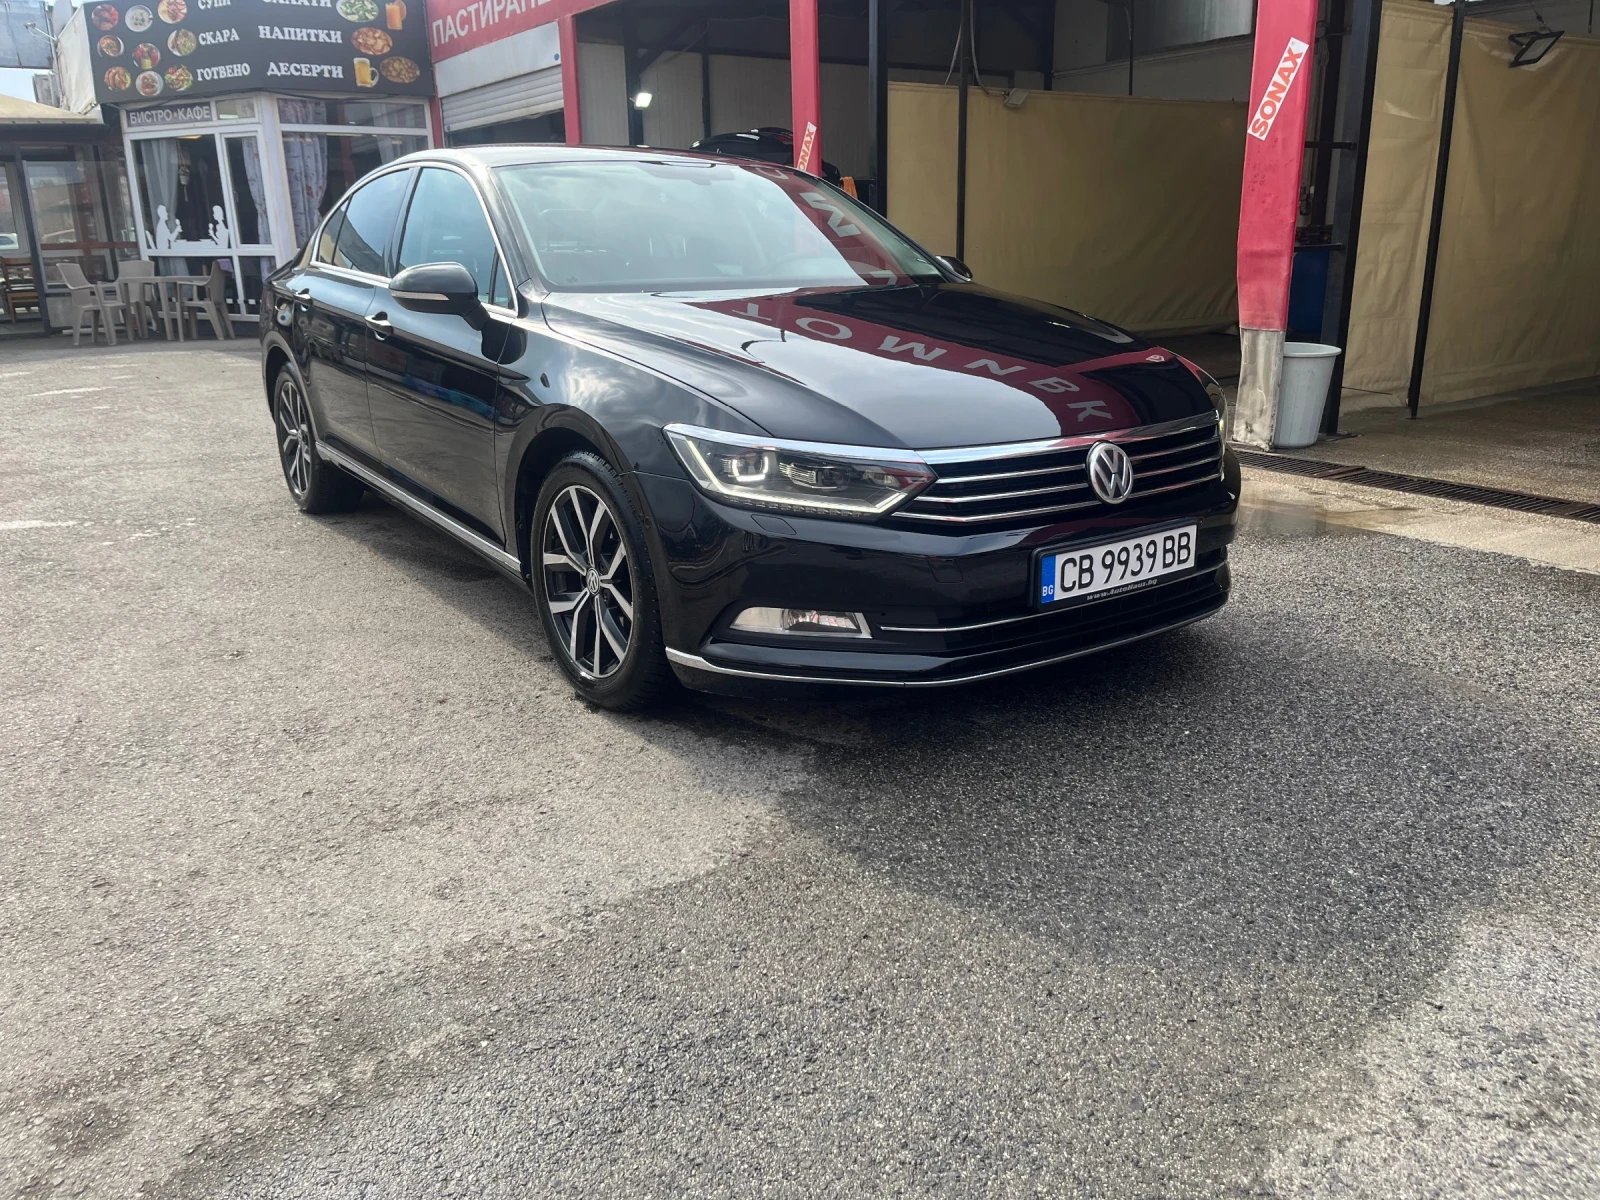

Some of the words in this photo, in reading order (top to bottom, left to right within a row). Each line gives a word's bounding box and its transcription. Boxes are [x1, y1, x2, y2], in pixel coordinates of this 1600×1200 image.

[432, 0, 551, 47] ПАСТИРА
[198, 27, 240, 46] СКАРА
[258, 25, 343, 44] НАПИТКИ
[196, 62, 251, 81] ГОТВЕНО
[266, 61, 344, 79] ДЕСЕРТИ
[1251, 46, 1304, 137] SONAX
[798, 127, 814, 171] ONAX
[1060, 553, 1095, 593] CB
[1101, 539, 1158, 585] 9939
[1162, 531, 1191, 570] BB
[1042, 584, 1054, 597] BG
